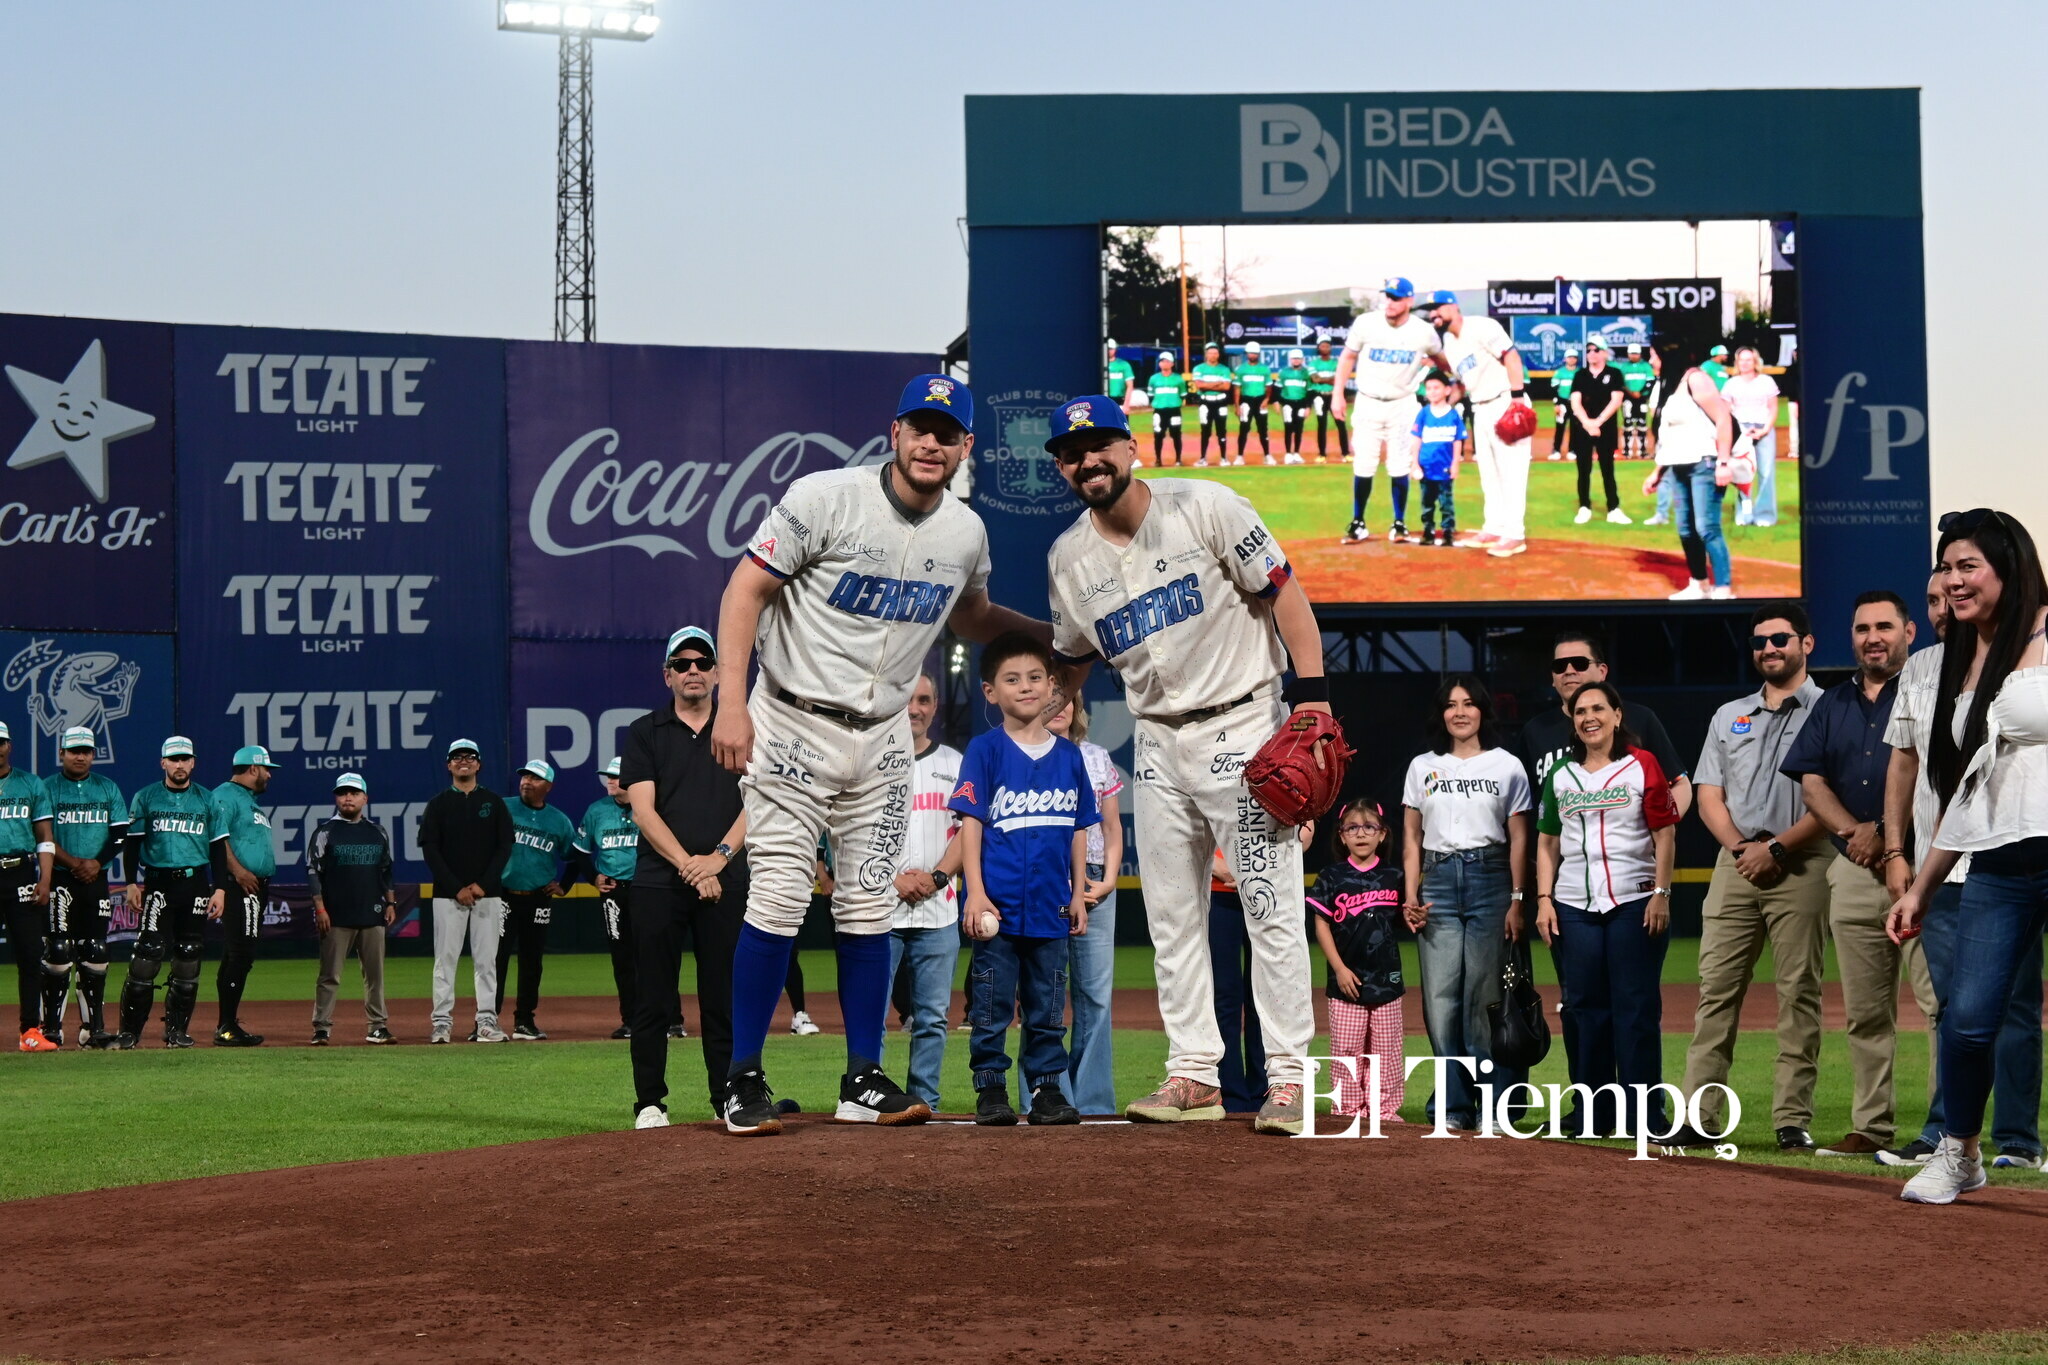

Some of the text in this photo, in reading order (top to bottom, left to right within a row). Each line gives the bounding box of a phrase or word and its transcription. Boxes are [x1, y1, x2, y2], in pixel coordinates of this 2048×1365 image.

[1364, 107, 1515, 147] BEDA
[1365, 158, 1656, 198] INDUSTRIAS
[1586, 286, 1716, 310] FUEL STOP
[216, 353, 430, 416] TECATE
[987, 390, 1070, 406] CLUB DE GOL
[296, 420, 358, 433] LIGHT
[1019, 421, 1046, 435] EL
[224, 462, 437, 522] TECATE
[529, 427, 894, 560] Coca-C
[0, 502, 157, 550] Carl's Jr.
[304, 528, 365, 540] LIGHT
[223, 575, 434, 634] TECATE
[302, 640, 363, 652] LIGHT
[226, 690, 437, 752] TECATE
[767, 739, 789, 750] Santa
[305, 756, 366, 769] LIGHT
[877, 750, 912, 771] Ford
[1210, 752, 1247, 774] For
[1135, 769, 1155, 781] AC
[1217, 773, 1243, 781] MONCLO
[57, 802, 98, 811] SARAPEROS
[152, 811, 194, 820] SARAPEROS
[58, 811, 108, 825] SALTILLO
[152, 819, 205, 835] SALTILLO
[873, 783, 899, 854] LUCKY EAGLE
[885, 783, 908, 857] CASINO
[514, 832, 554, 852] ALTILLO
[1237, 796, 1251, 873] LUCKY EAGLE
[1249, 796, 1267, 873] CASINO
[1268, 828, 1278, 869] HOTEL
